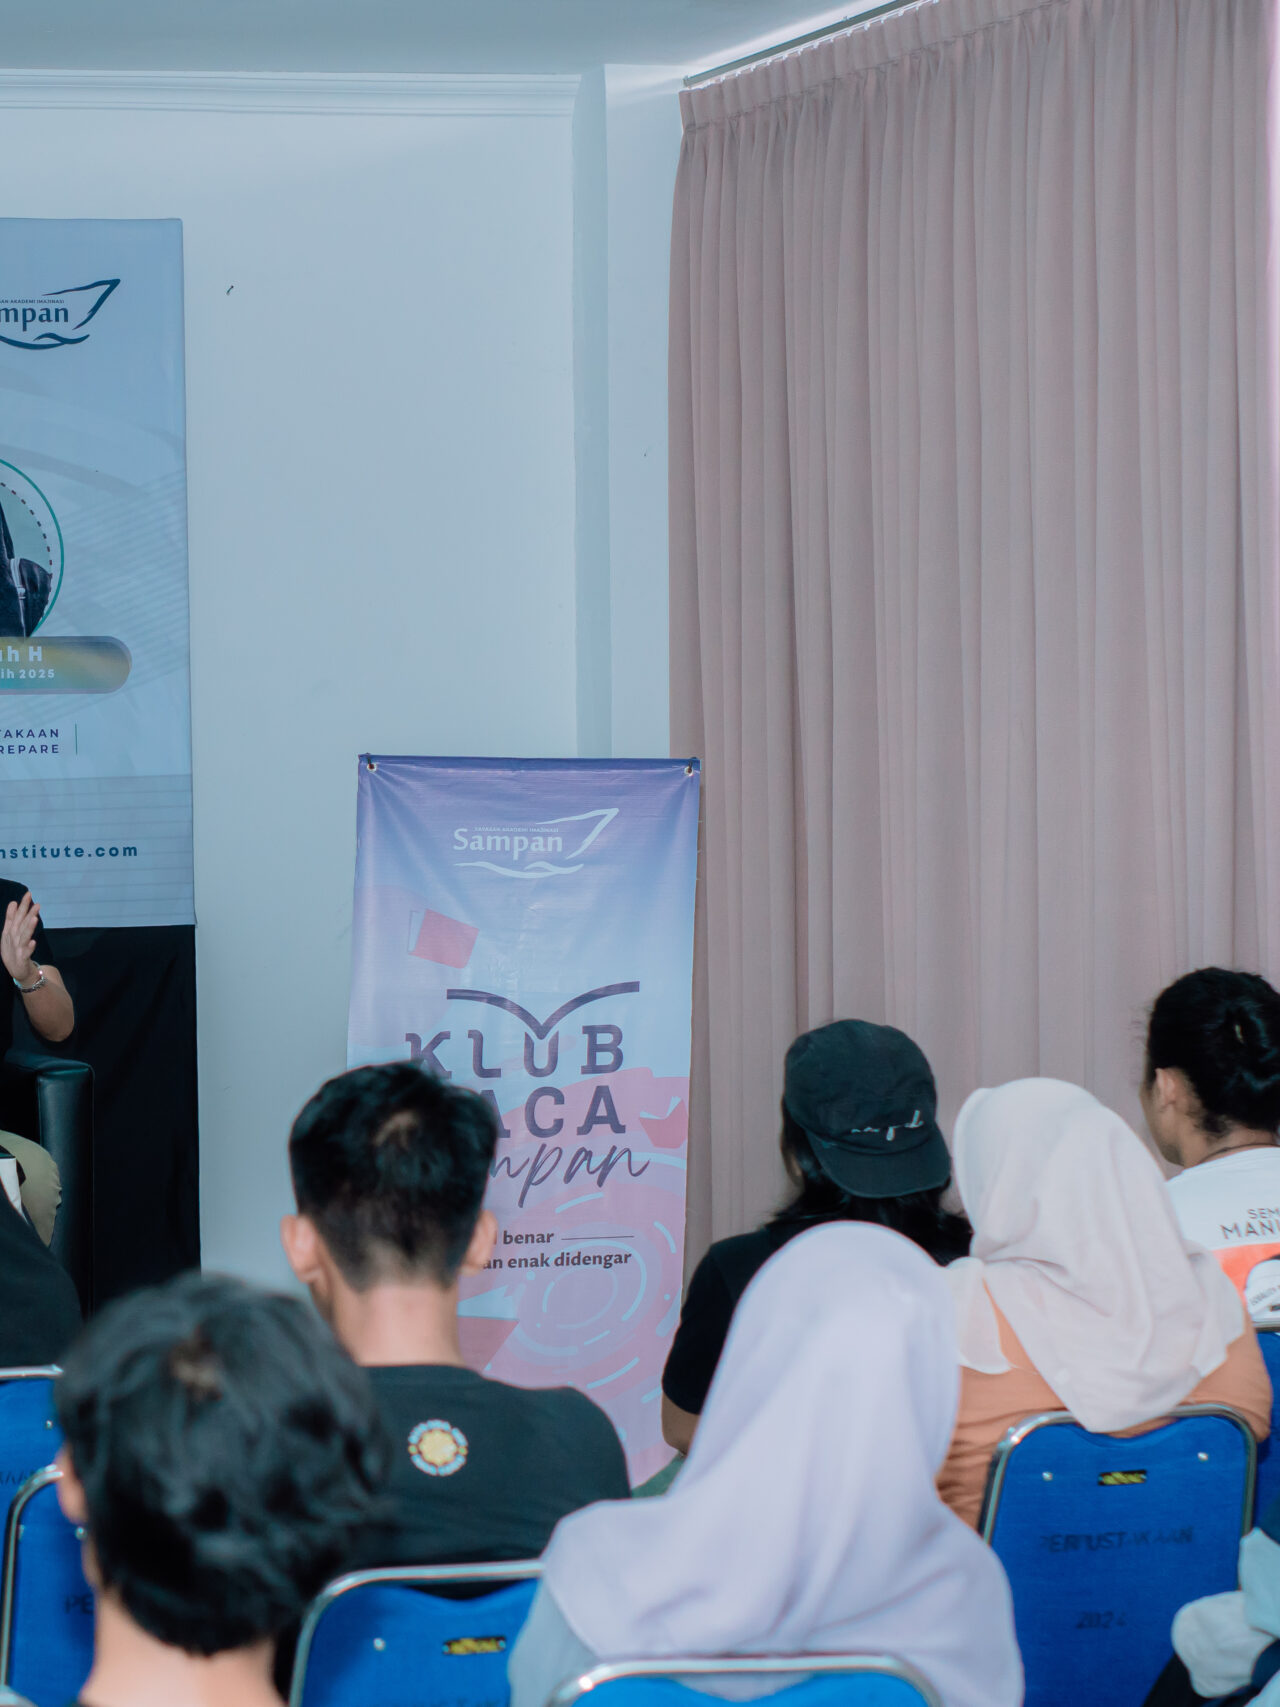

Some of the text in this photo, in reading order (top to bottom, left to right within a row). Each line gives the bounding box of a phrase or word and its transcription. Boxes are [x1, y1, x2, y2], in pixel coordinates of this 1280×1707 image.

[28, 646, 43, 662] H
[19, 667, 56, 679] 2025
[453, 828, 563, 860] Sampan
[405, 1024, 625, 1079] KLUB
[503, 1230, 555, 1245] benar
[482, 1250, 632, 1270] an enak didengar
